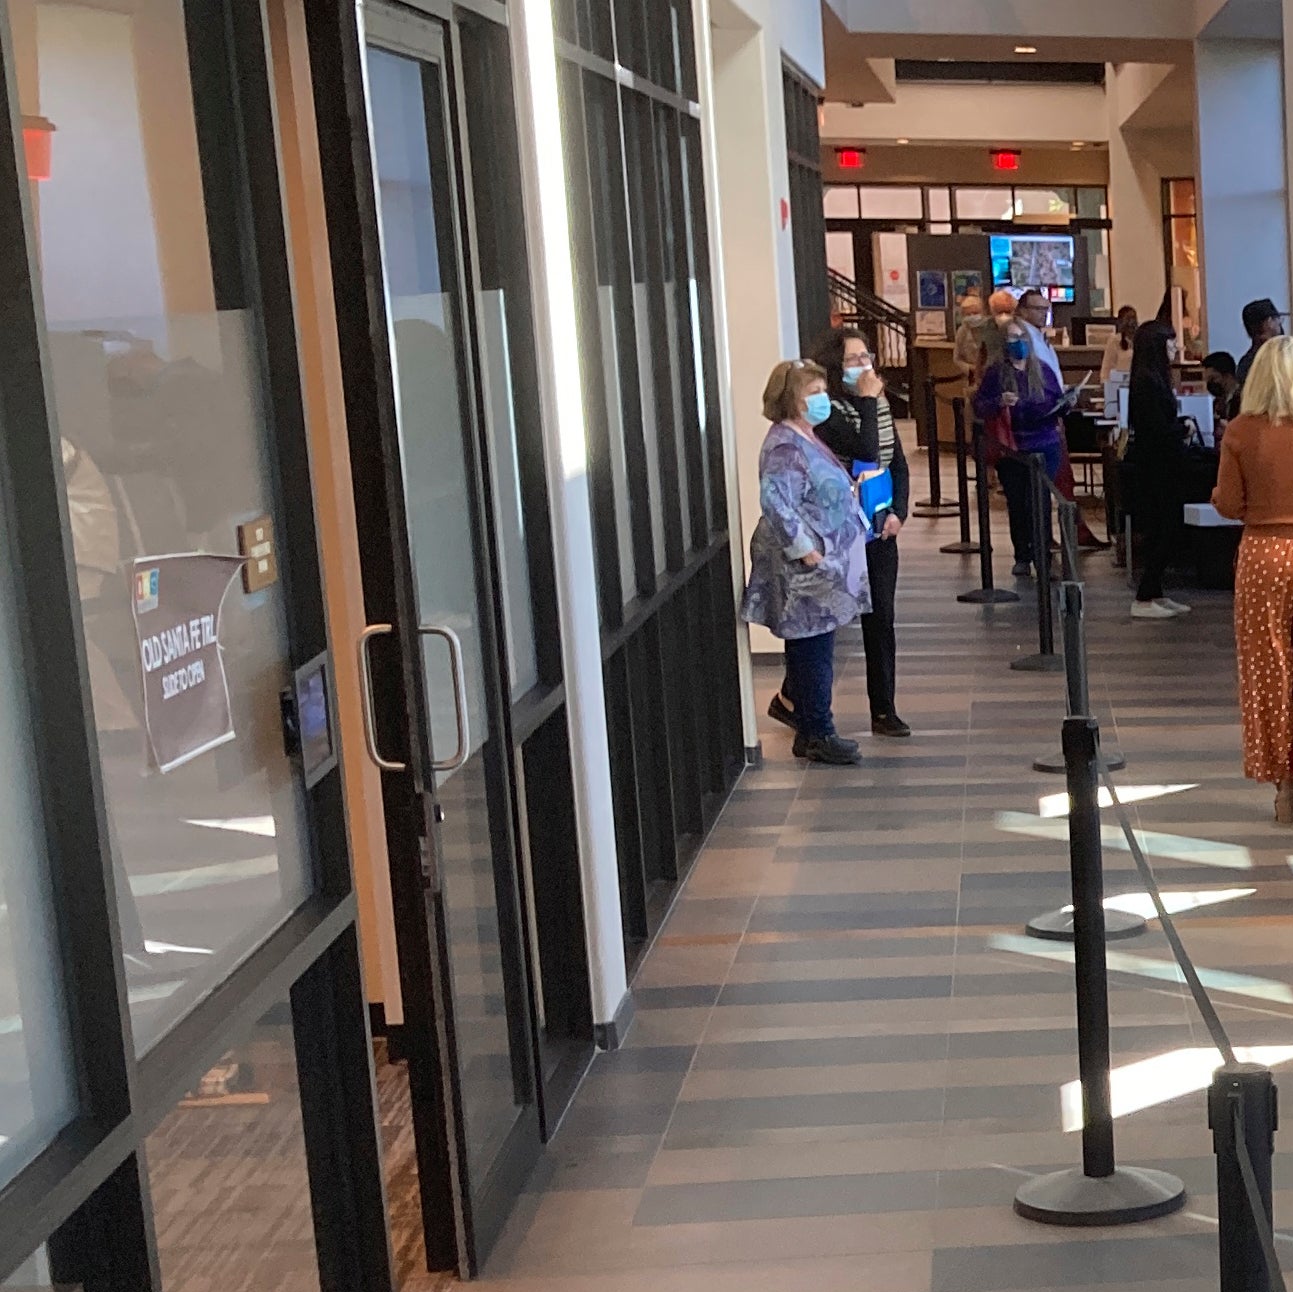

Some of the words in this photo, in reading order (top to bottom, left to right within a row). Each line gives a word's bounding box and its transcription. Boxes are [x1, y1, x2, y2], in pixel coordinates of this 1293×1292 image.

[143, 635, 163, 672] OLD
[161, 623, 190, 664] SANTA
[189, 619, 202, 651] FE
[200, 613, 217, 646] TRL
